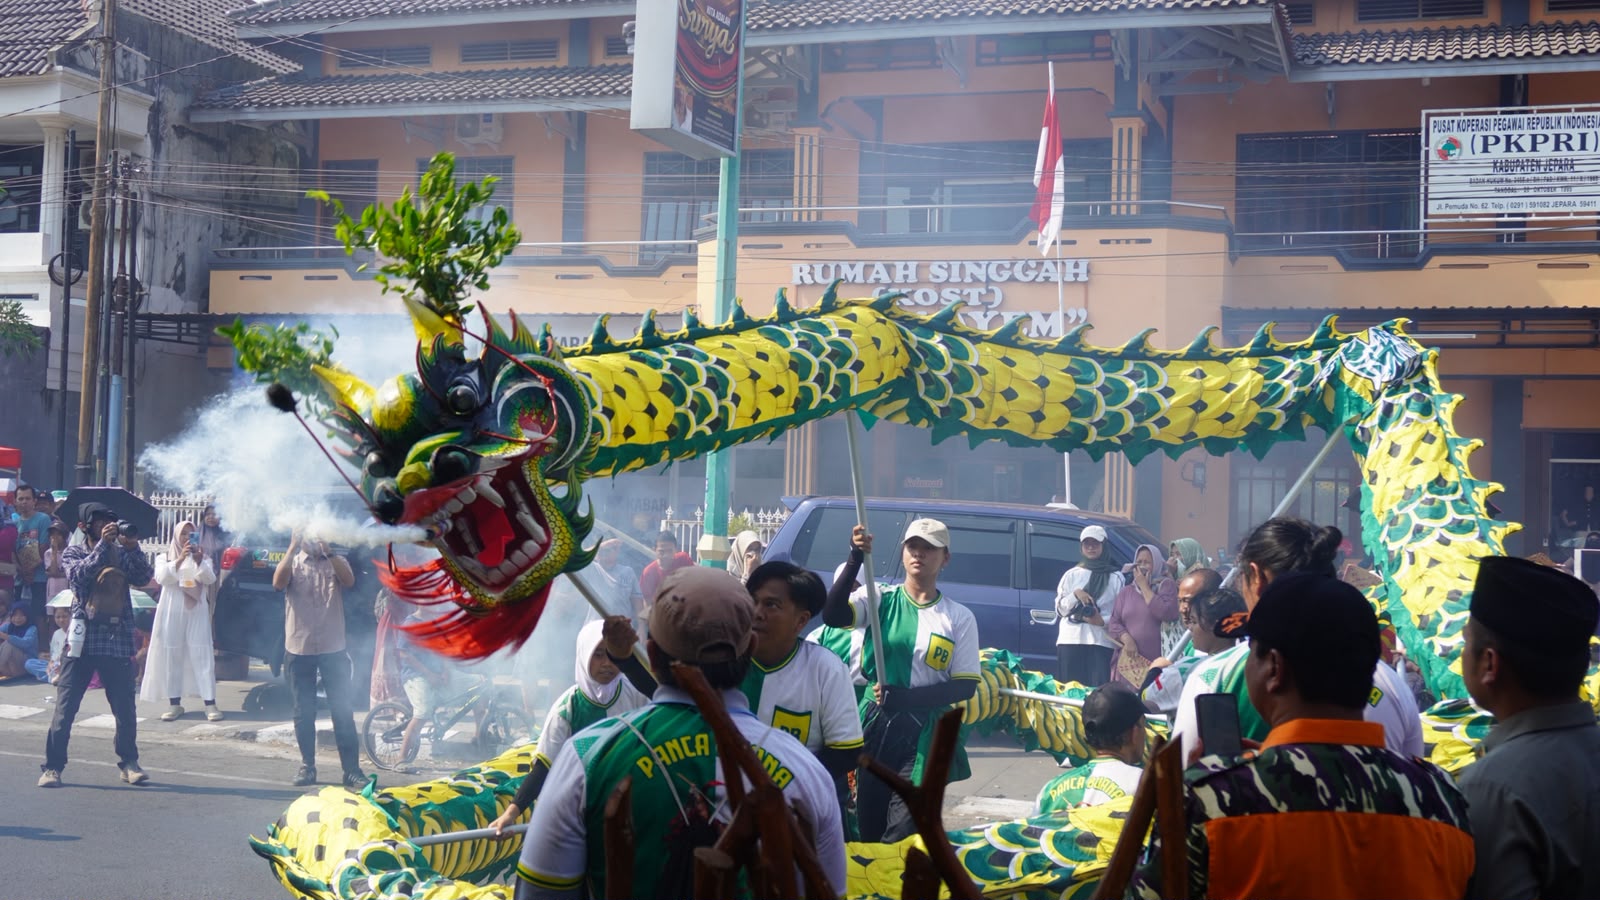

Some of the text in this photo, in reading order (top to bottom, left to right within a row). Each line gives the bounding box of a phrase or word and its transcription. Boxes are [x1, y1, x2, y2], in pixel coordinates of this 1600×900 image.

[679, 0, 739, 59] Surya
[1433, 119, 1455, 134] PUSAT
[1456, 118, 1491, 133] KOPERASI
[1493, 117, 1525, 132] PEGAWAI
[1526, 116, 1562, 131] REPUBLIK
[1471, 131, 1599, 155] (PKPRI)
[1492, 157, 1575, 173] KABUPATEN JEPARA
[1551, 200, 1577, 208] JEPARA
[791, 259, 1089, 284] RUMAH SINGGAH
[932, 645, 949, 664] PB
[635, 732, 710, 779] PANCA
[1049, 776, 1126, 802] PANCA BUANA
